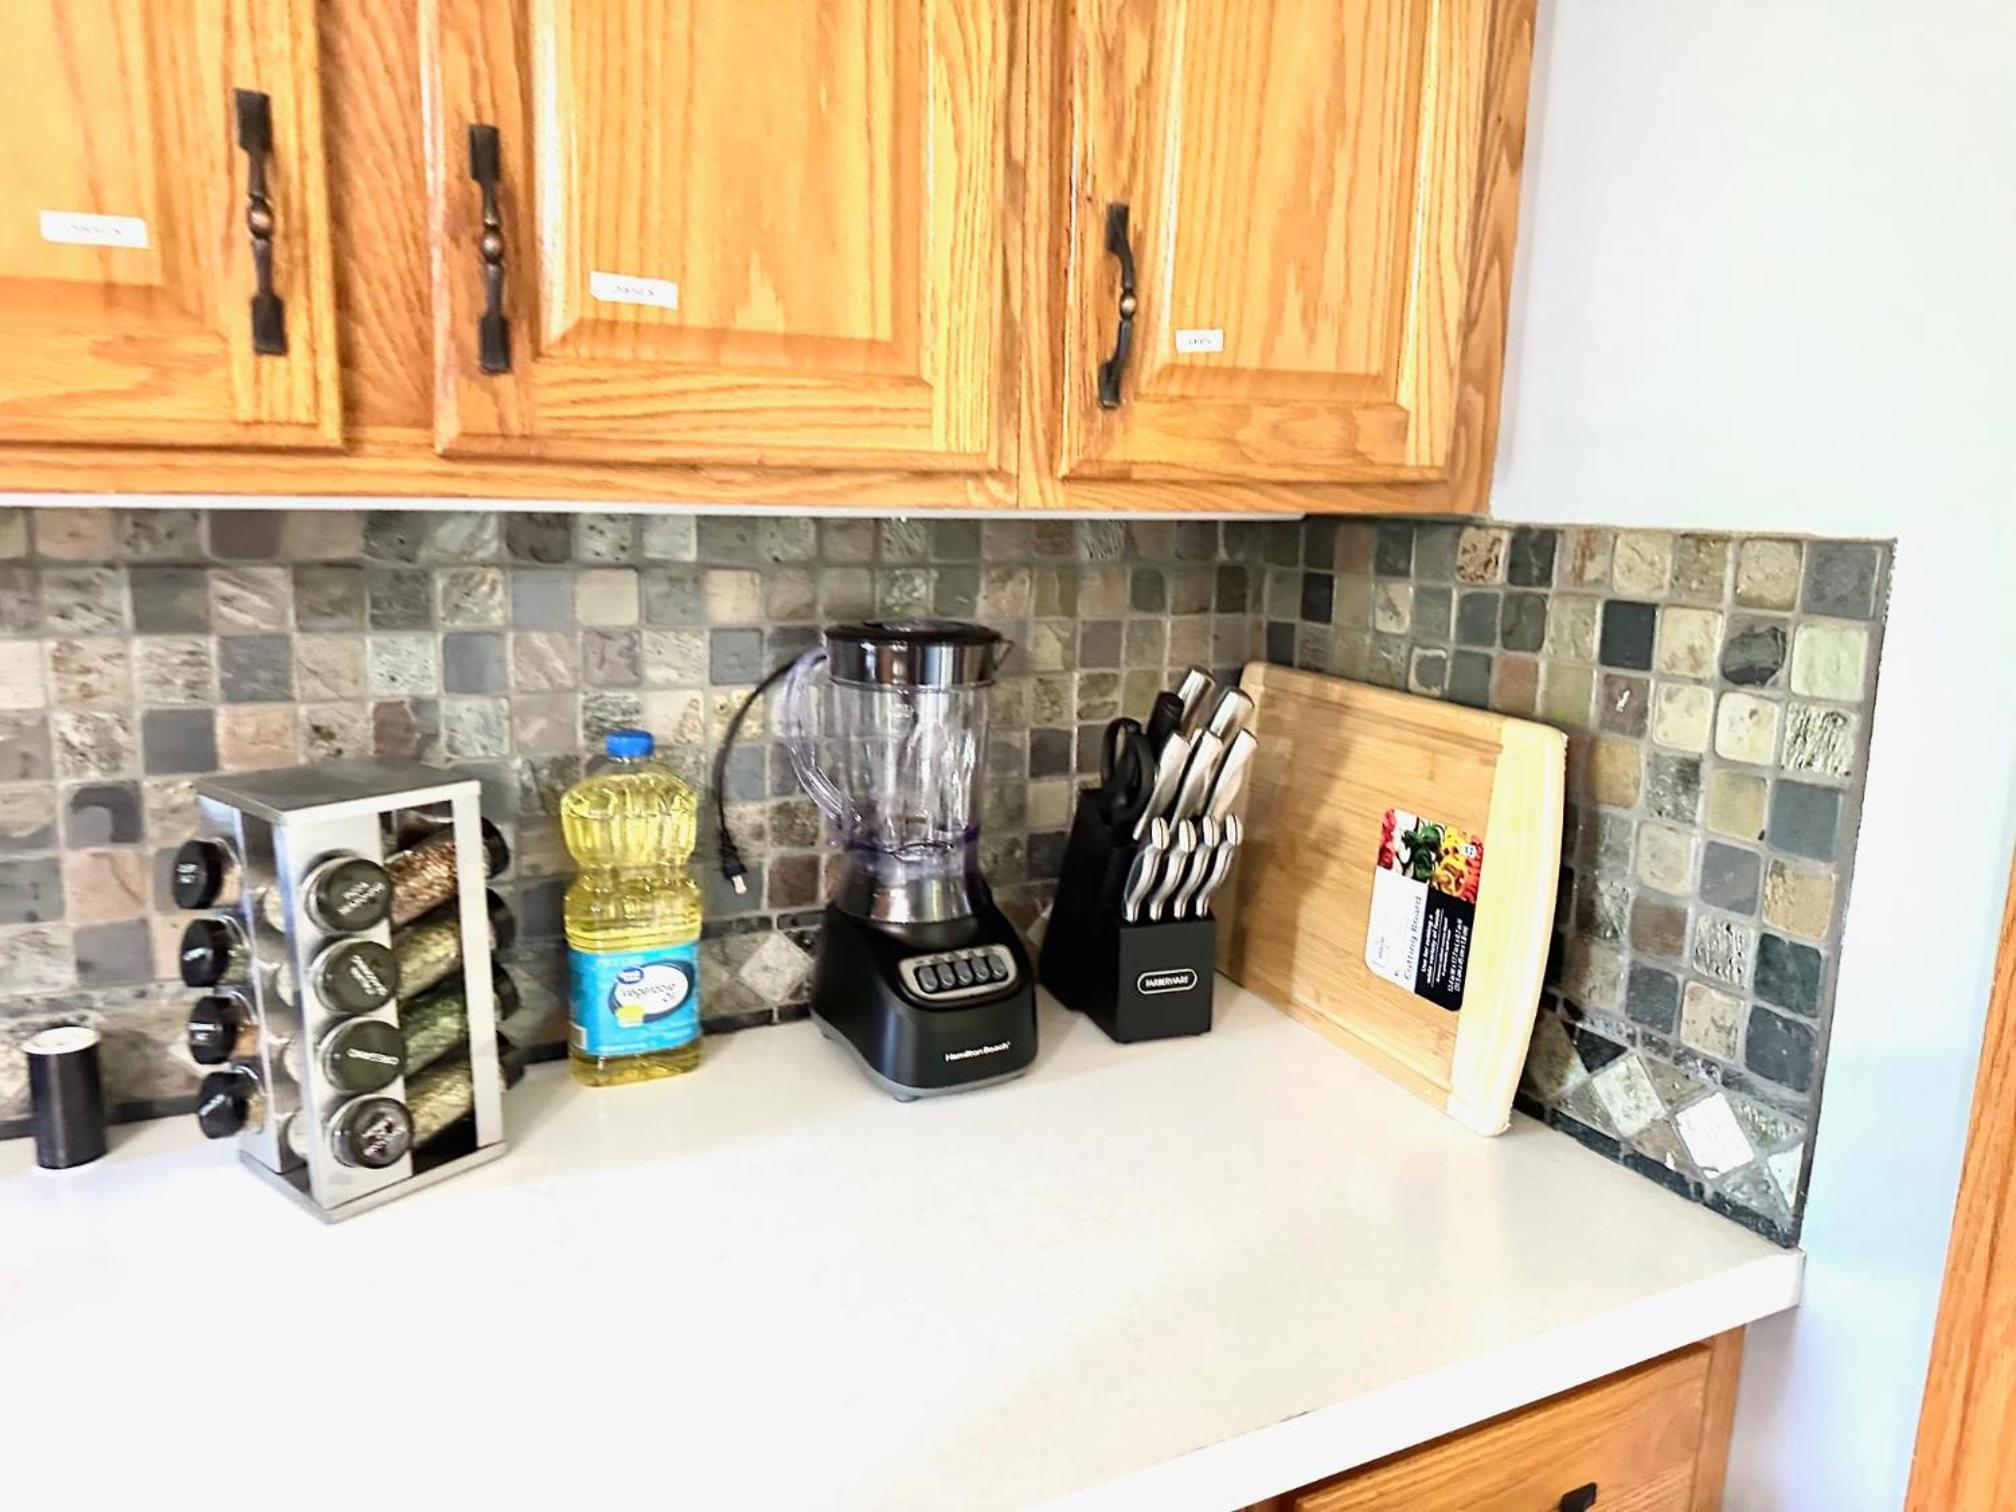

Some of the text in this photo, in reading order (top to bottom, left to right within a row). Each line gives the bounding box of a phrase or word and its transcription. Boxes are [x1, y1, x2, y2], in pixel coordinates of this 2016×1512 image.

[1405, 896, 1421, 979] Cutting Board
[945, 1049, 983, 1062] Hamilton
